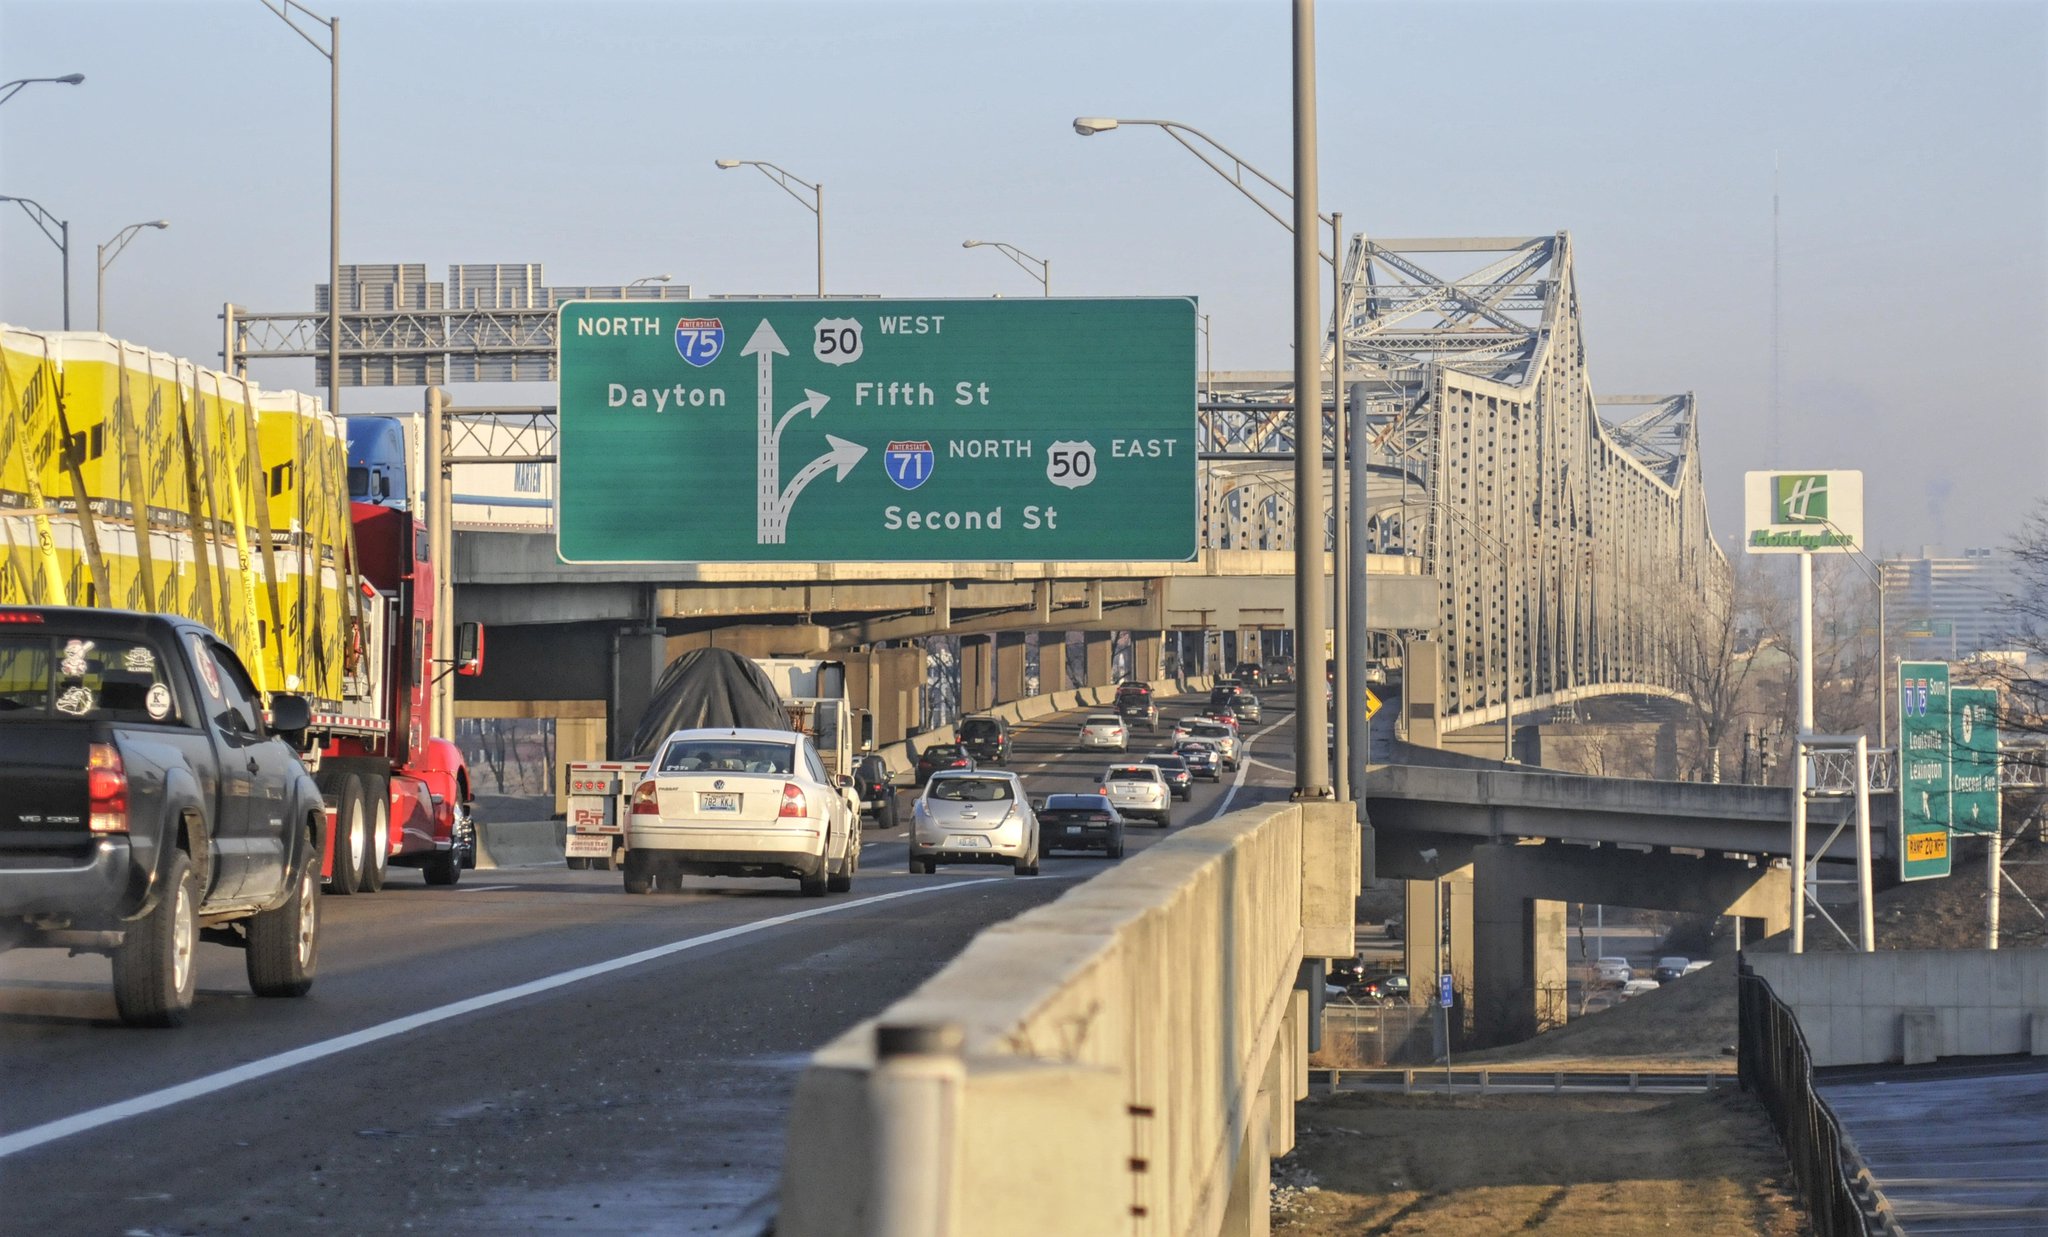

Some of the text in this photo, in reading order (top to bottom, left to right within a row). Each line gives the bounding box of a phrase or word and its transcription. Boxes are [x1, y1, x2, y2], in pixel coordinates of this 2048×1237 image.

[577, 317, 660, 337] NORTH
[682, 319, 718, 329] INTERSTATE
[879, 316, 945, 335] WEST
[682, 331, 718, 358] 75
[818, 328, 859, 355] 50
[608, 382, 726, 413] Dayton
[855, 382, 990, 406] Fifth St
[891, 442, 927, 452] INTERSTATE
[949, 439, 1032, 459] NORTH
[1111, 439, 1178, 458] EAST
[895, 454, 924, 481] 71
[1052, 451, 1091, 478] 50
[884, 506, 1058, 530] Second St
[1750, 530, 1822, 551] Holiday
[1906, 689, 1914, 706] 71
[1918, 688, 1927, 708] 75
[1909, 730, 1942, 750] Louisville
[1909, 761, 1942, 784] Lexington
[1954, 773, 1996, 793] Crescent Ave
[704, 798, 717, 807] 782
[18, 815, 42, 823] V6
[1909, 839, 1923, 854] RAMP
[1924, 837, 1933, 855] 20
